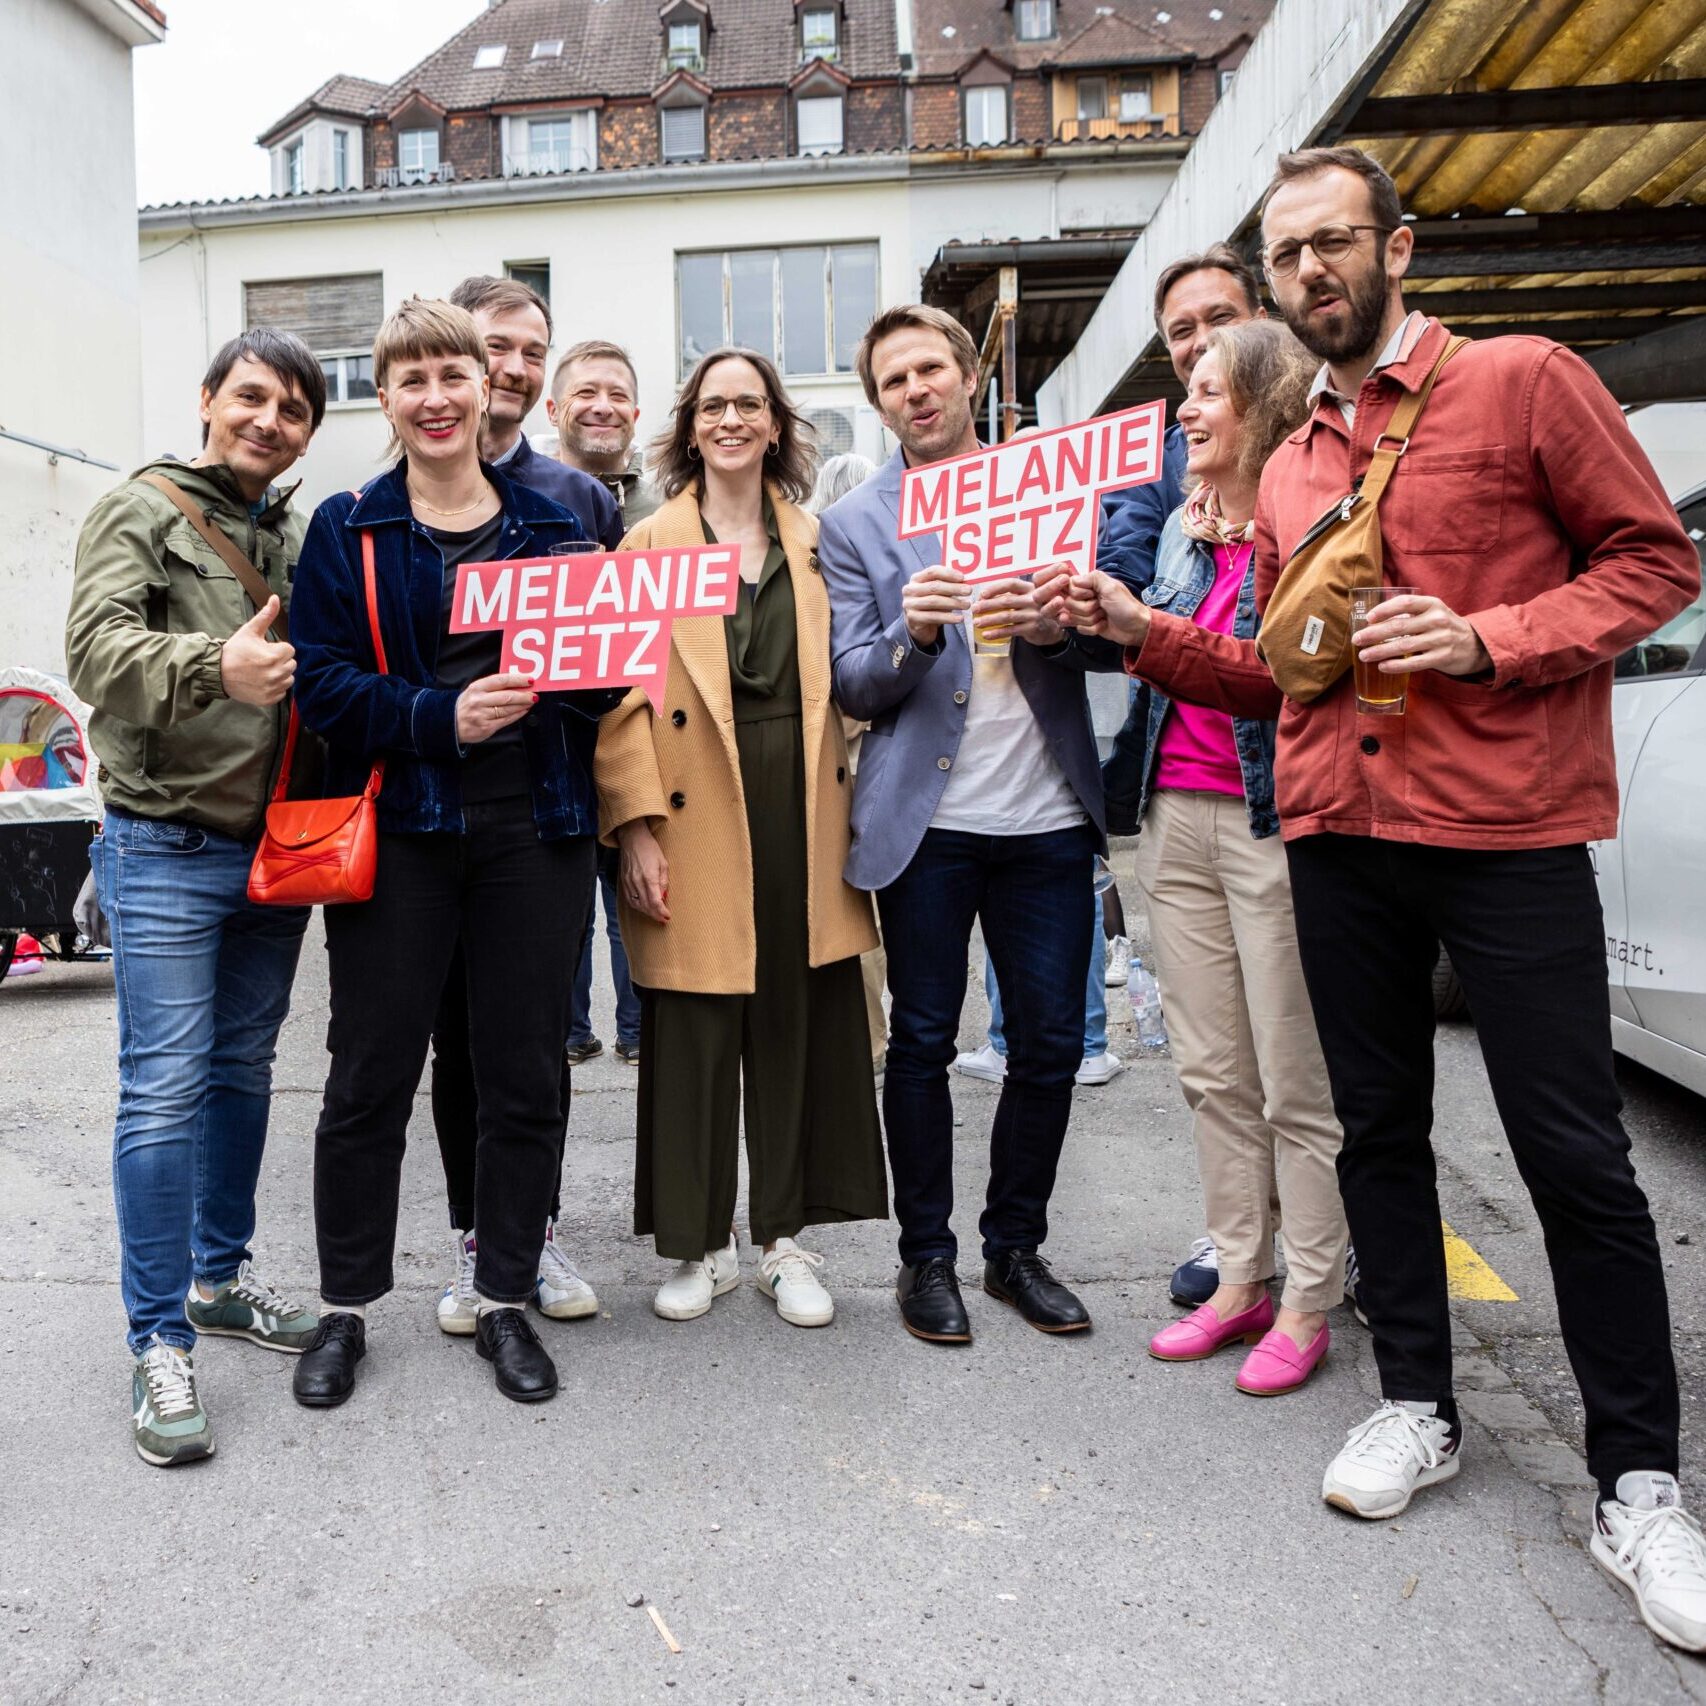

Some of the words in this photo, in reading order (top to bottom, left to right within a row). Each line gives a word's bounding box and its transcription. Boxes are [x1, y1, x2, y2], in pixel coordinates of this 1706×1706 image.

[909, 415, 1151, 527] MELANIE
[951, 497, 1085, 575] SETZ
[461, 551, 731, 625] MELANIE
[508, 620, 661, 681] SETZ
